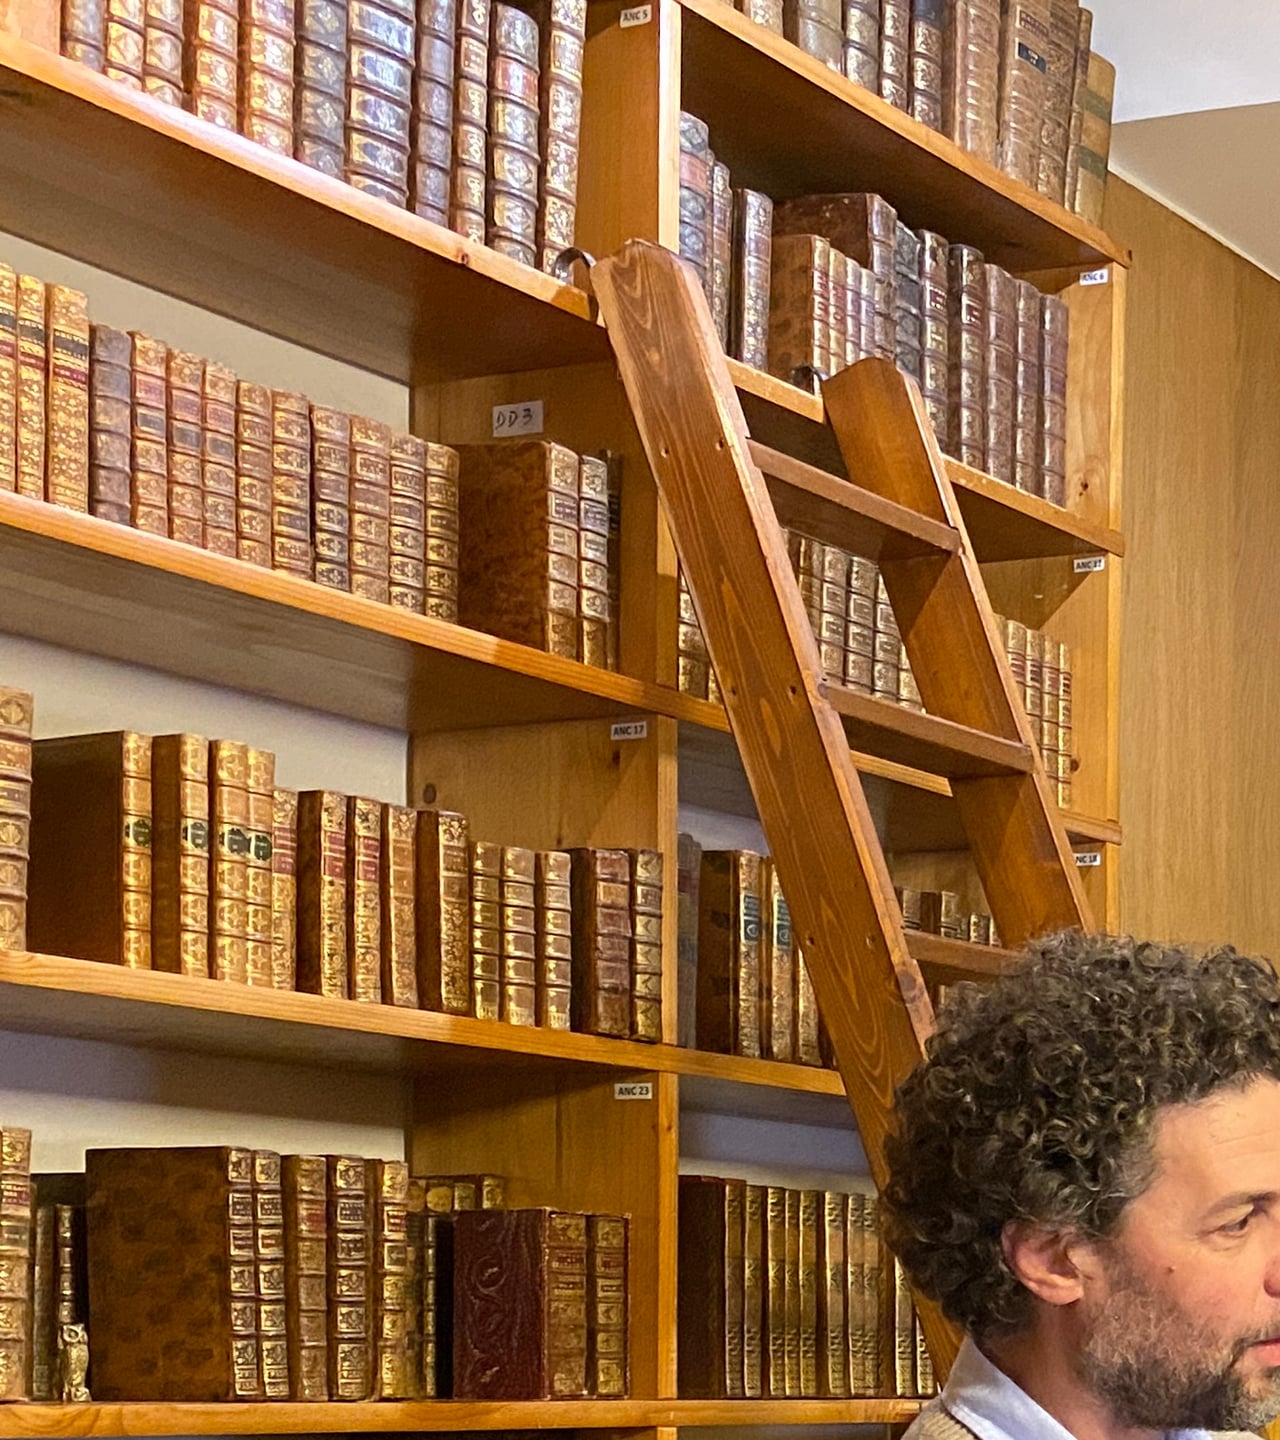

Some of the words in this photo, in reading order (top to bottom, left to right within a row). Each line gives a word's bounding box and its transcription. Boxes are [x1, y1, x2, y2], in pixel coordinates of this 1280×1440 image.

[613, 725, 631, 737] ANC
[633, 724, 645, 736] 17
[618, 1086, 637, 1096] ANC
[638, 1086, 649, 1096] 23
